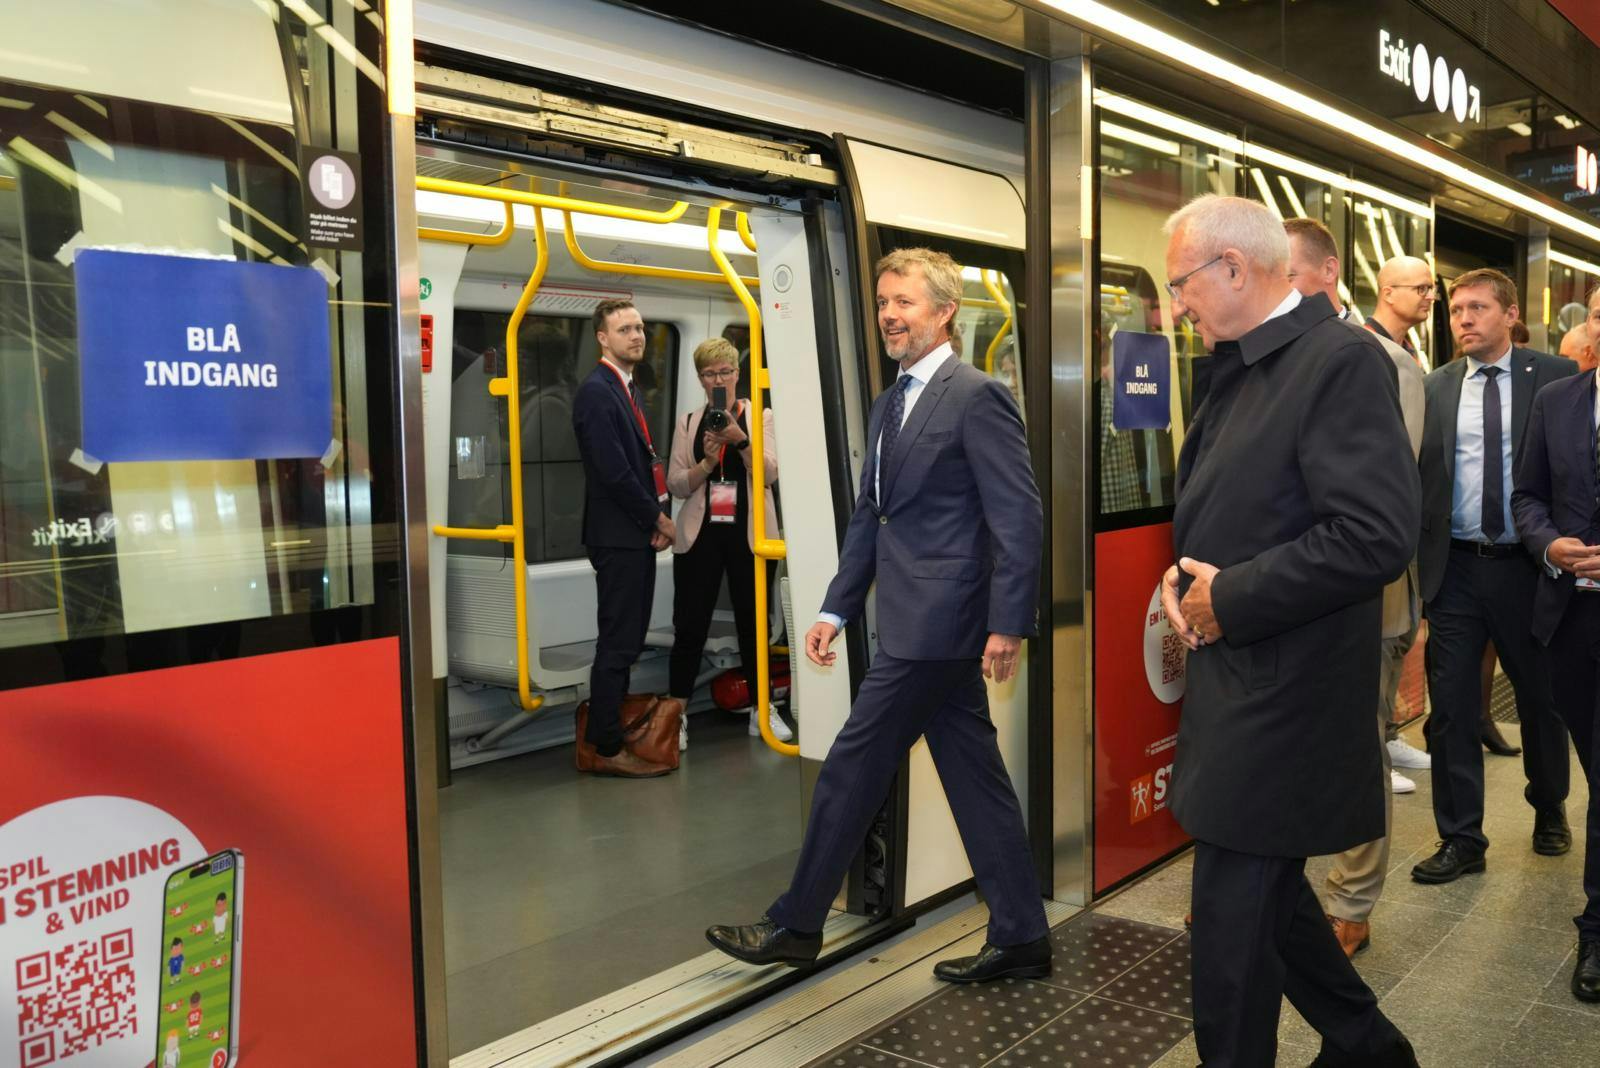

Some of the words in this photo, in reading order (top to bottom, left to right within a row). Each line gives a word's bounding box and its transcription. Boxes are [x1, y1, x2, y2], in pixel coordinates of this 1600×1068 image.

[1380, 29, 1411, 87] Exit
[187, 323, 241, 353] BLÅ
[144, 361, 278, 387] INDGANG
[1135, 363, 1149, 378] BLÅ
[1126, 381, 1158, 395] INDGANG
[15, 838, 180, 918] STEMNING
[45, 912, 65, 935] &
[70, 888, 130, 925] VIND
